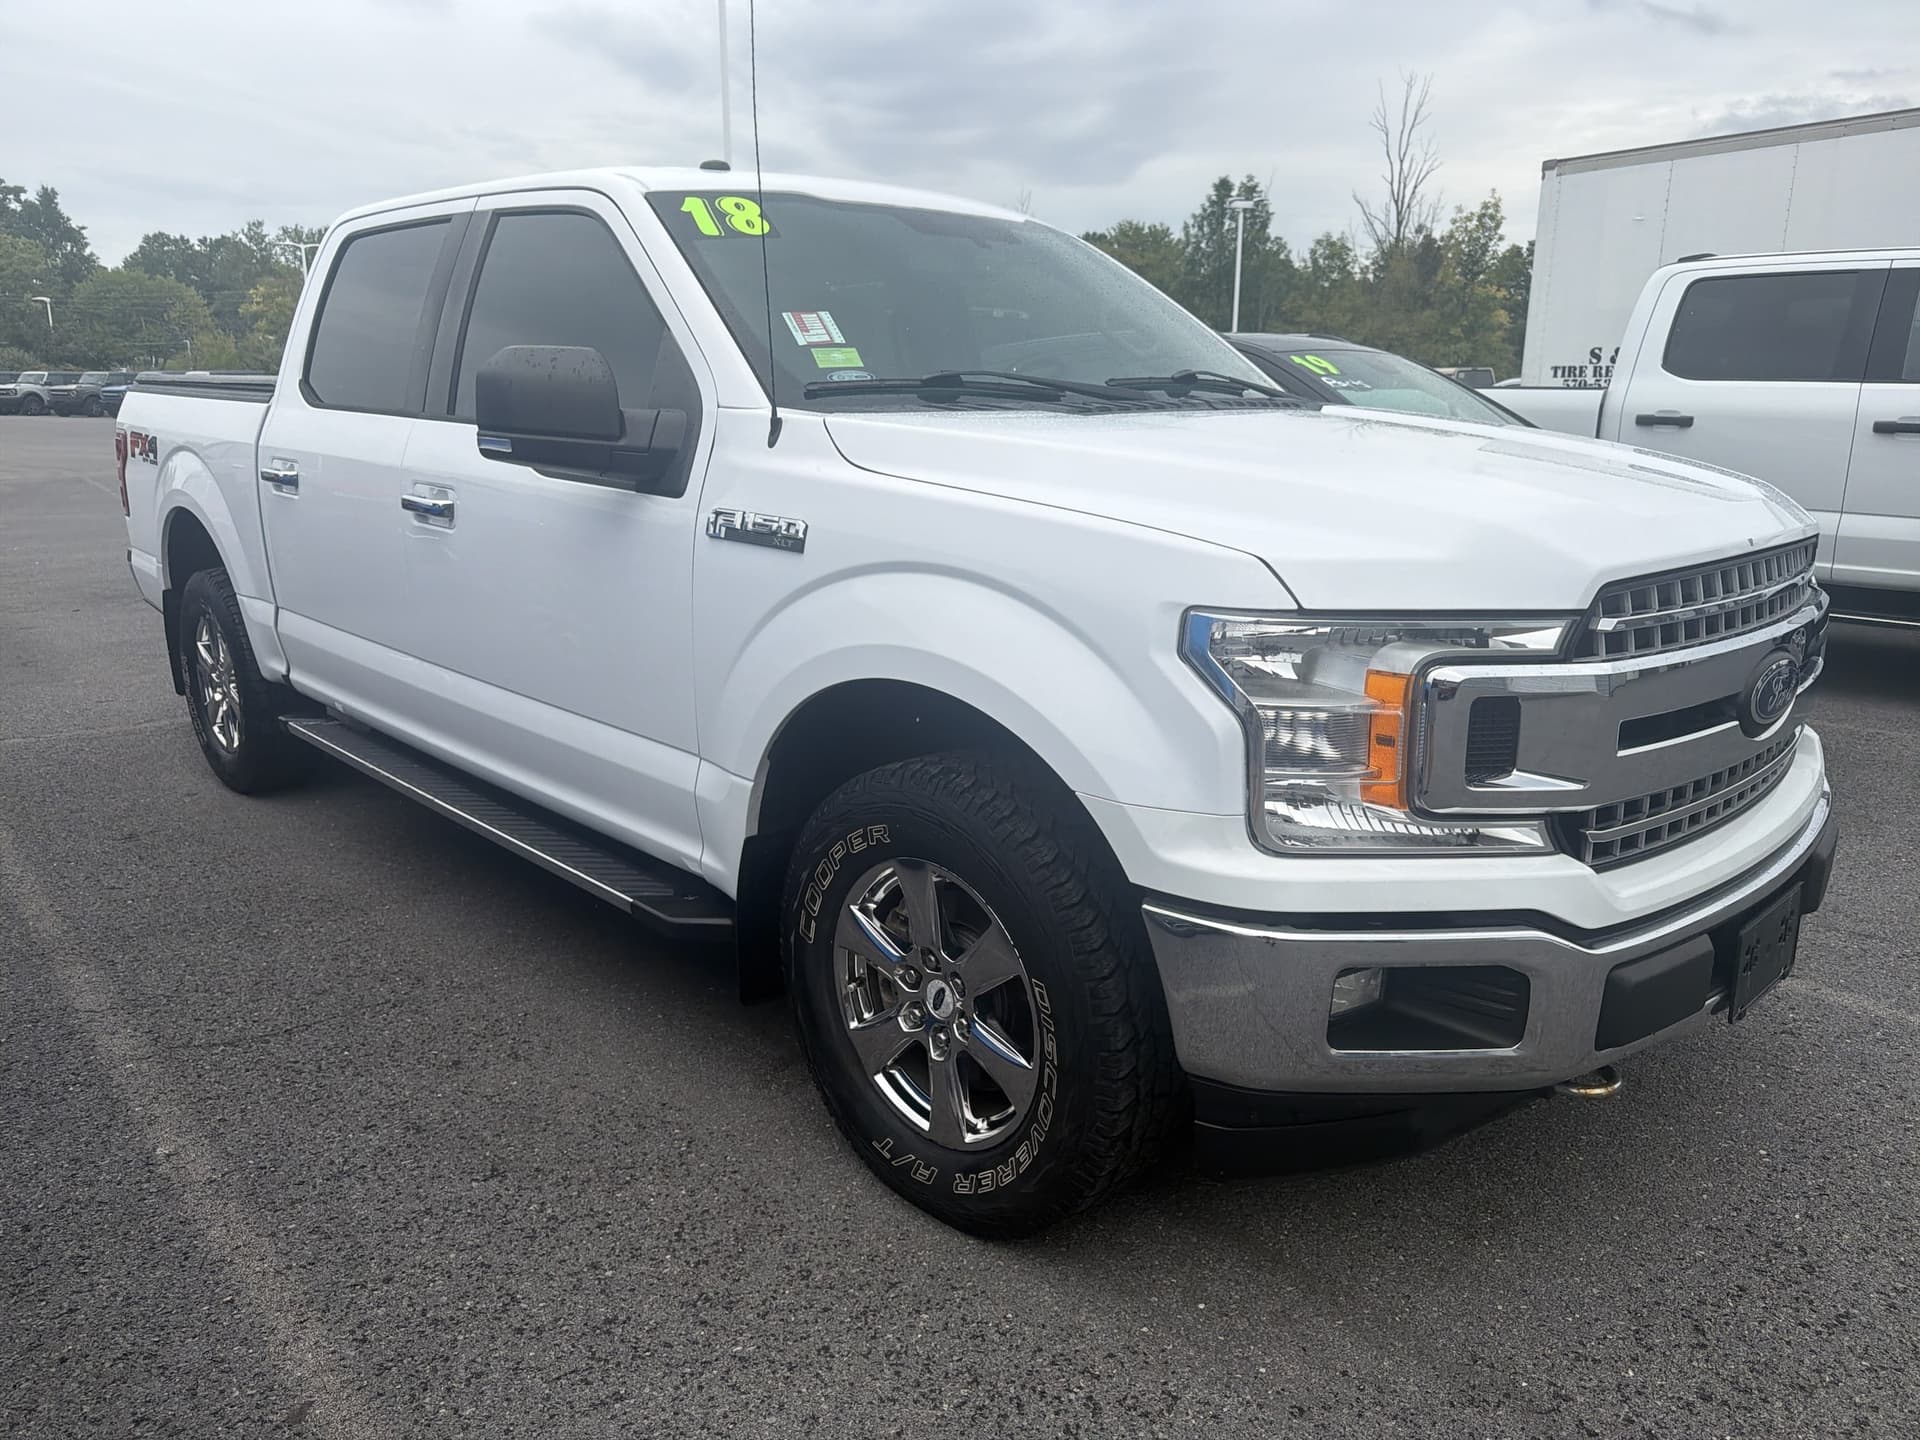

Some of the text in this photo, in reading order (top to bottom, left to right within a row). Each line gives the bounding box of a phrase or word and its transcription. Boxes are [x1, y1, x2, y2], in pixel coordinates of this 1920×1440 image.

[680, 196, 770, 236] 18
[1289, 355, 1341, 375] 19
[1589, 346, 1603, 365] S
[1550, 365, 1588, 379] TIRE
[130, 431, 158, 460] FX4
[799, 824, 891, 944] COOPER
[871, 978, 1058, 1194] DISCOVERER A/T
